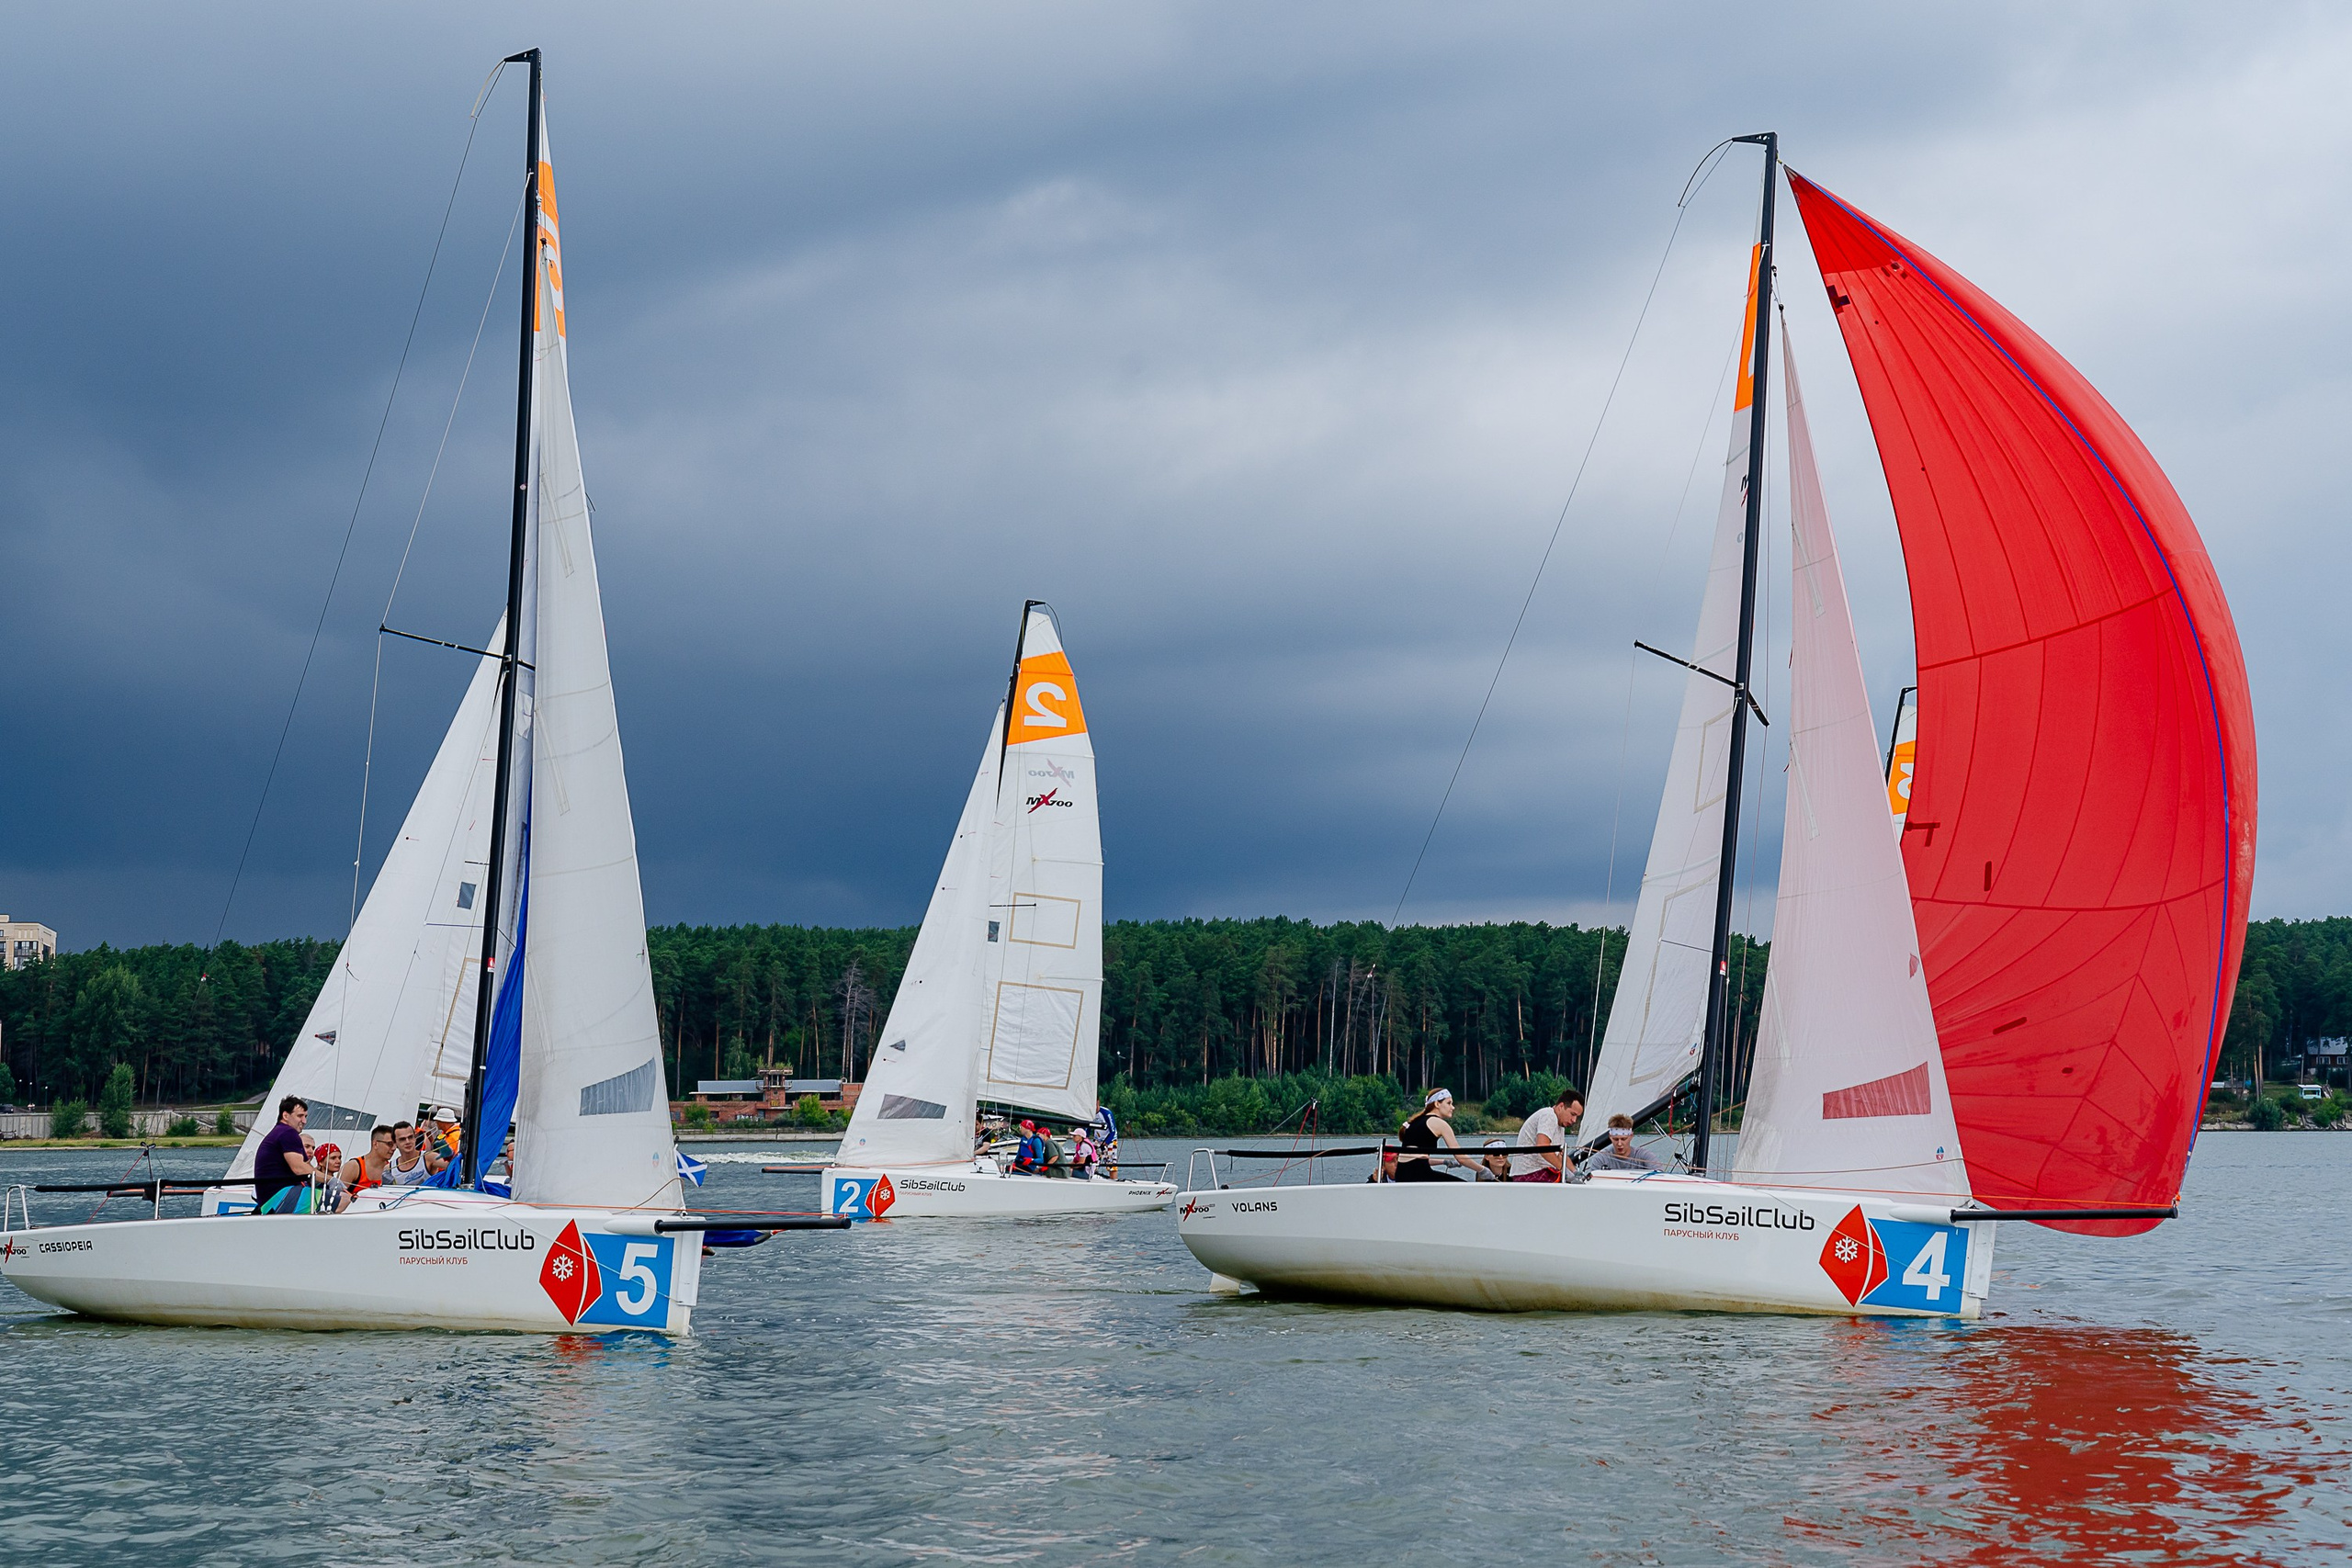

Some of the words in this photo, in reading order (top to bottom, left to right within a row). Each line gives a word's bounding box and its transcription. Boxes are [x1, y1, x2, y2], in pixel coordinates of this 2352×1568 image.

[1026, 788, 1073, 814] MX700
[839, 1181, 861, 1213] 2
[899, 1179, 966, 1192] SibSailClub
[1180, 1196, 1209, 1222] MX700
[1231, 1201, 1278, 1213] VOLANS
[1664, 1202, 1815, 1231] SibSailClub
[398, 1229, 535, 1250] SibSailClub
[1663, 1228, 1713, 1239] ПАРУСНЫЙ
[1715, 1232, 1739, 1241] КЛУБ
[39, 1240, 93, 1253] CASSIOPEIA
[400, 1256, 445, 1265] ПАРУСНЫЙ
[447, 1257, 469, 1265] КЛУБ
[1902, 1232, 1951, 1301] 4
[616, 1242, 659, 1315] 5
